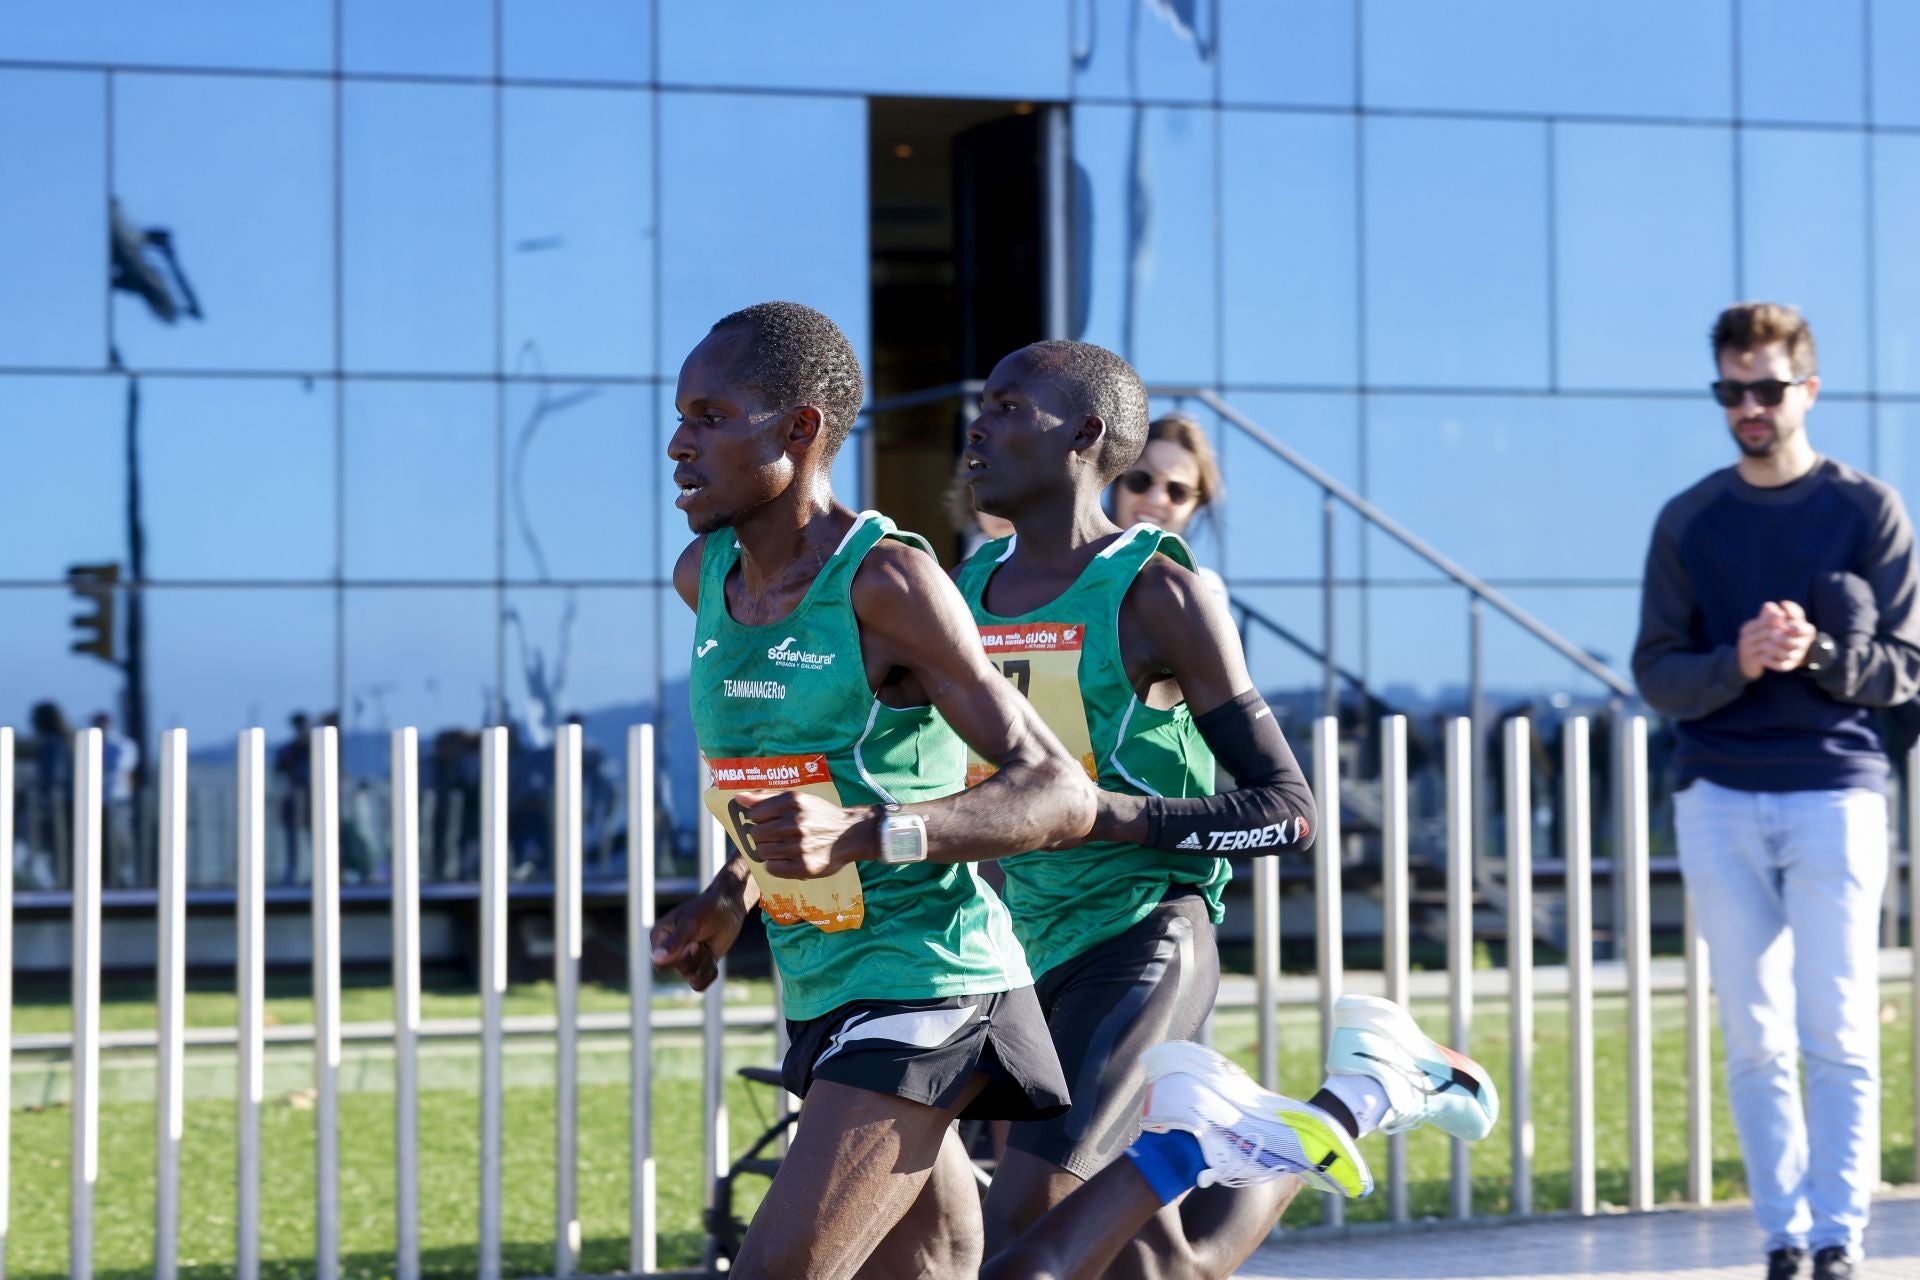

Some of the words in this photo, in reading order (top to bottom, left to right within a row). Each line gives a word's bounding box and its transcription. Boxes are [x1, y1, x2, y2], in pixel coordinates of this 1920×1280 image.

[1025, 630, 1057, 644] GIJÓN
[767, 648, 833, 665] SoriaNatural
[723, 679, 786, 700] TEAMMANAGER10
[991, 660, 1030, 700] 7
[718, 768, 746, 781] MBA
[766, 764, 800, 781] GIJÓN
[1206, 819, 1288, 851] TERREX
